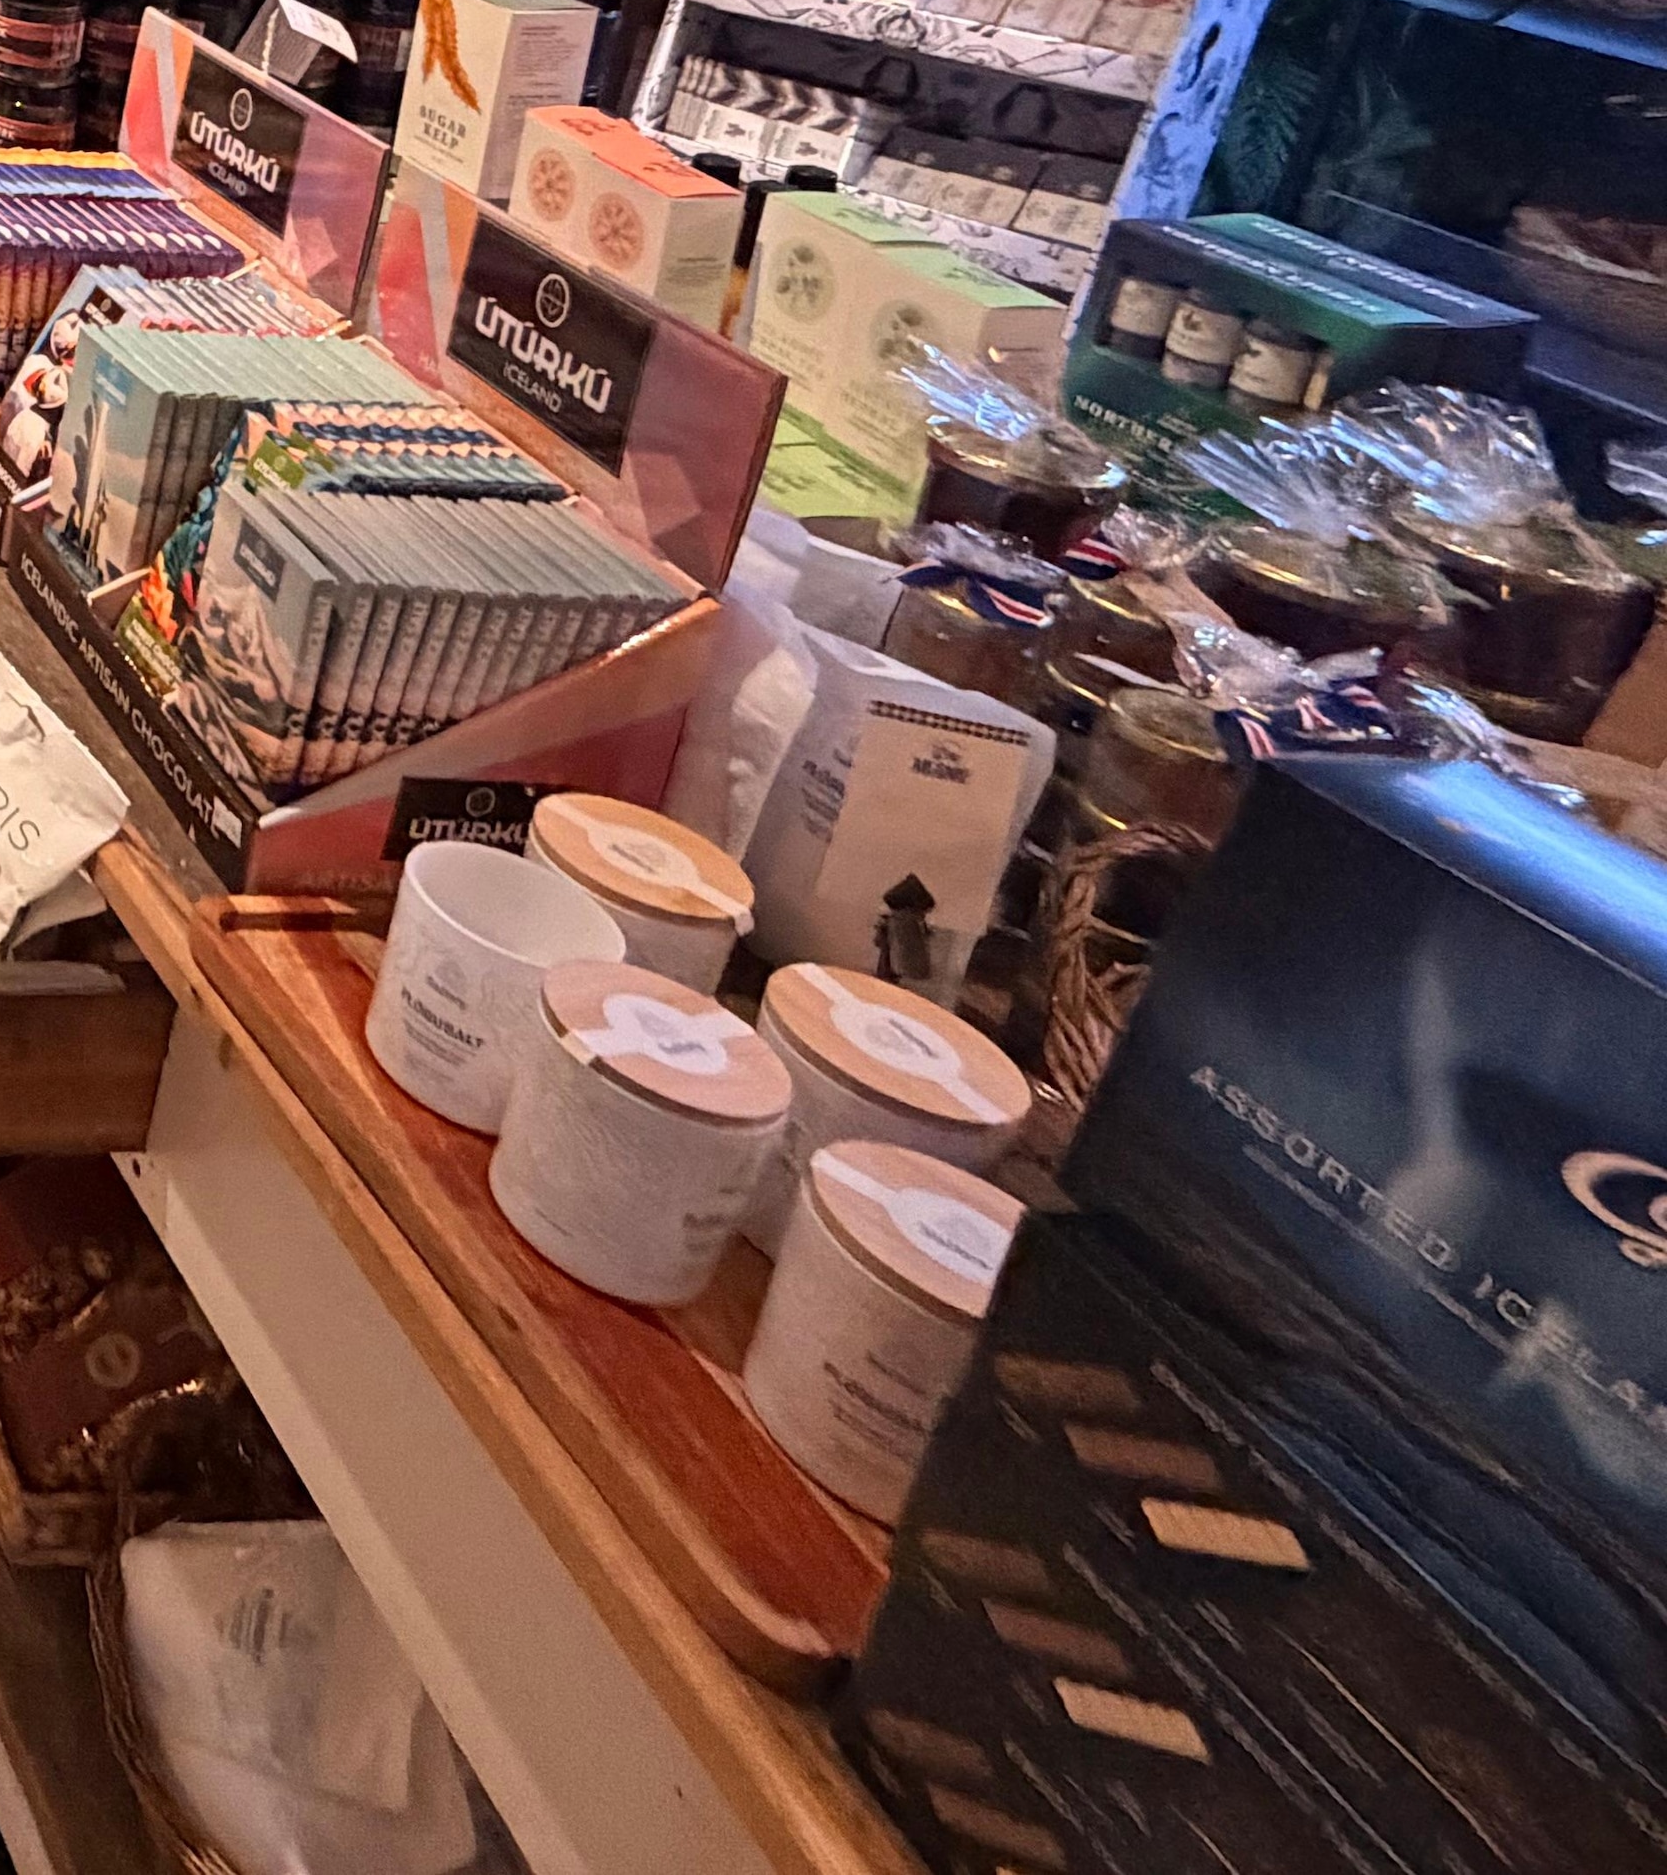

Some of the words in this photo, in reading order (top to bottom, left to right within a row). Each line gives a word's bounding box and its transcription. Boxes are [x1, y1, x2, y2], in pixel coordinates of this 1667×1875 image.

[419, 104, 467, 139] SUGAR
[422, 122, 459, 150] KELP
[503, 361, 563, 415] ICELAND
[21, 552, 81, 644] ICELANDIC
[78, 636, 131, 715] ARTISAN
[1188, 1063, 1462, 1274] ASSORTED
